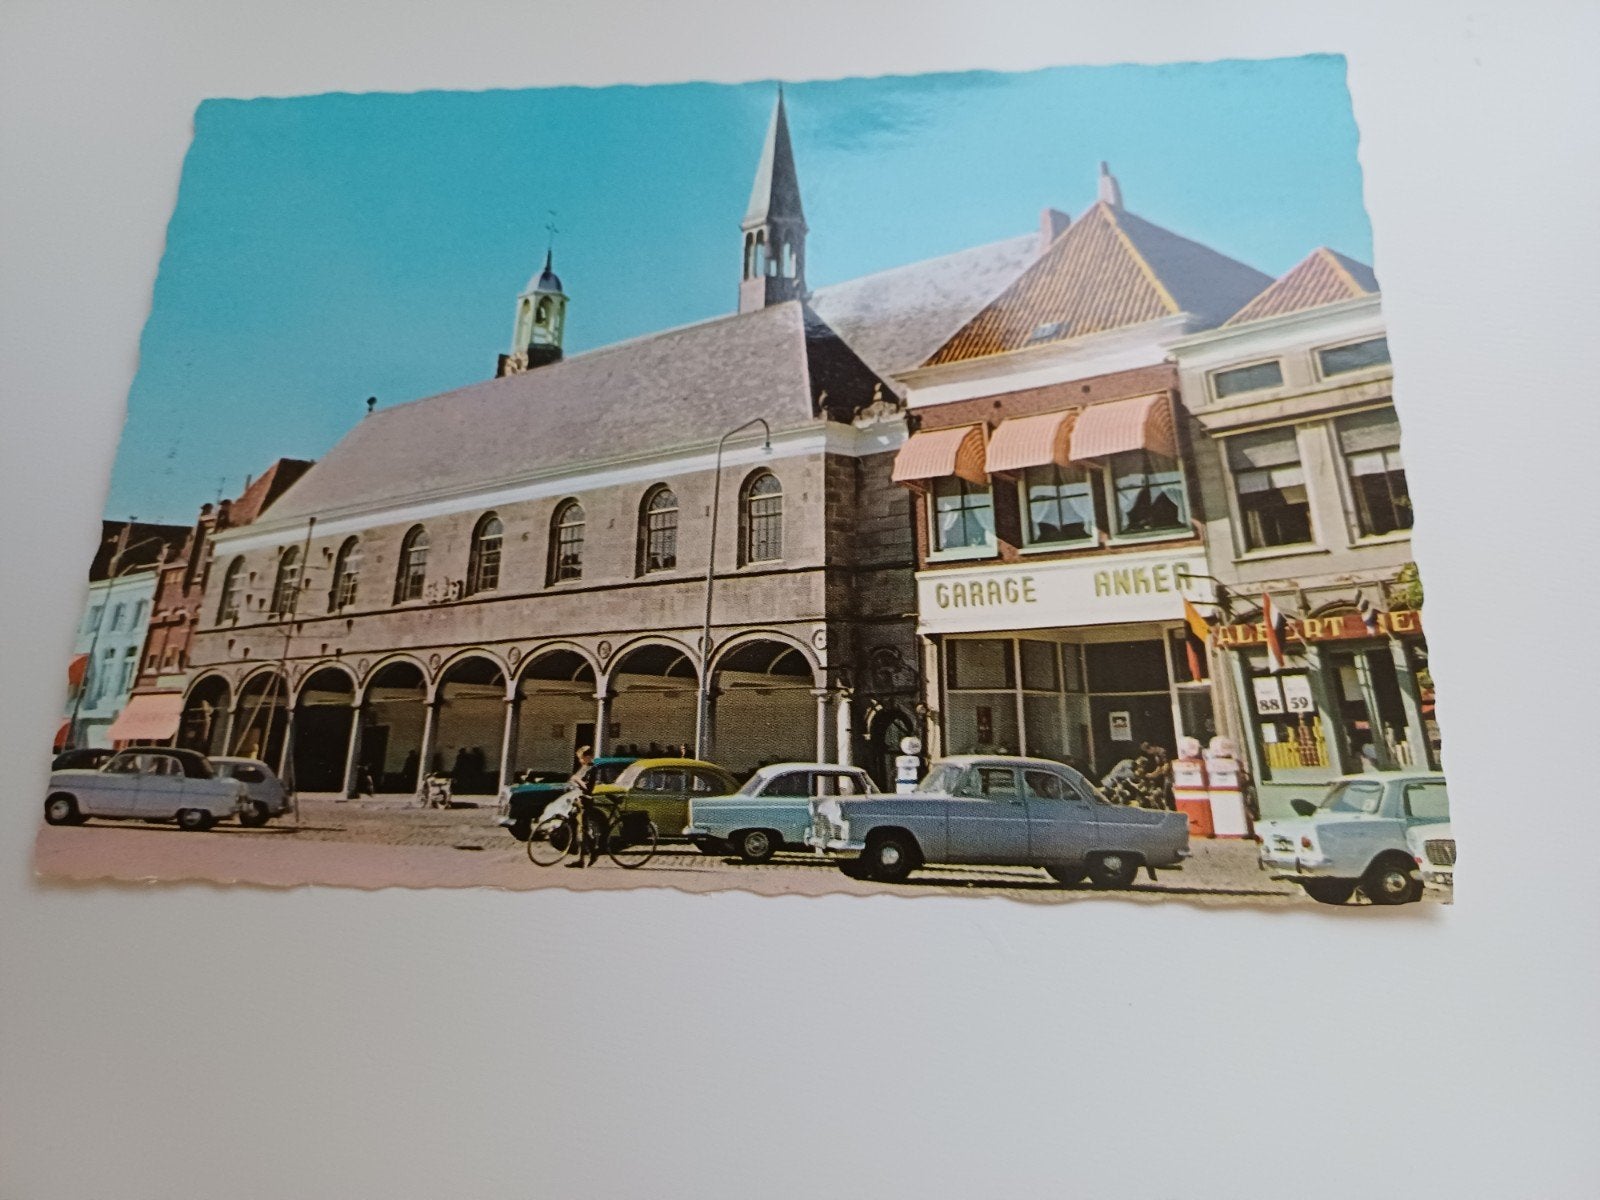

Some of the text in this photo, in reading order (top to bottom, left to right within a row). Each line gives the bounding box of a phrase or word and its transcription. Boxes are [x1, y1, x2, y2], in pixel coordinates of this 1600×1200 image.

[935, 561, 1193, 609] GARAGE ANKER
[1260, 699, 1280, 711] 88
[1290, 697, 1308, 709] 59
